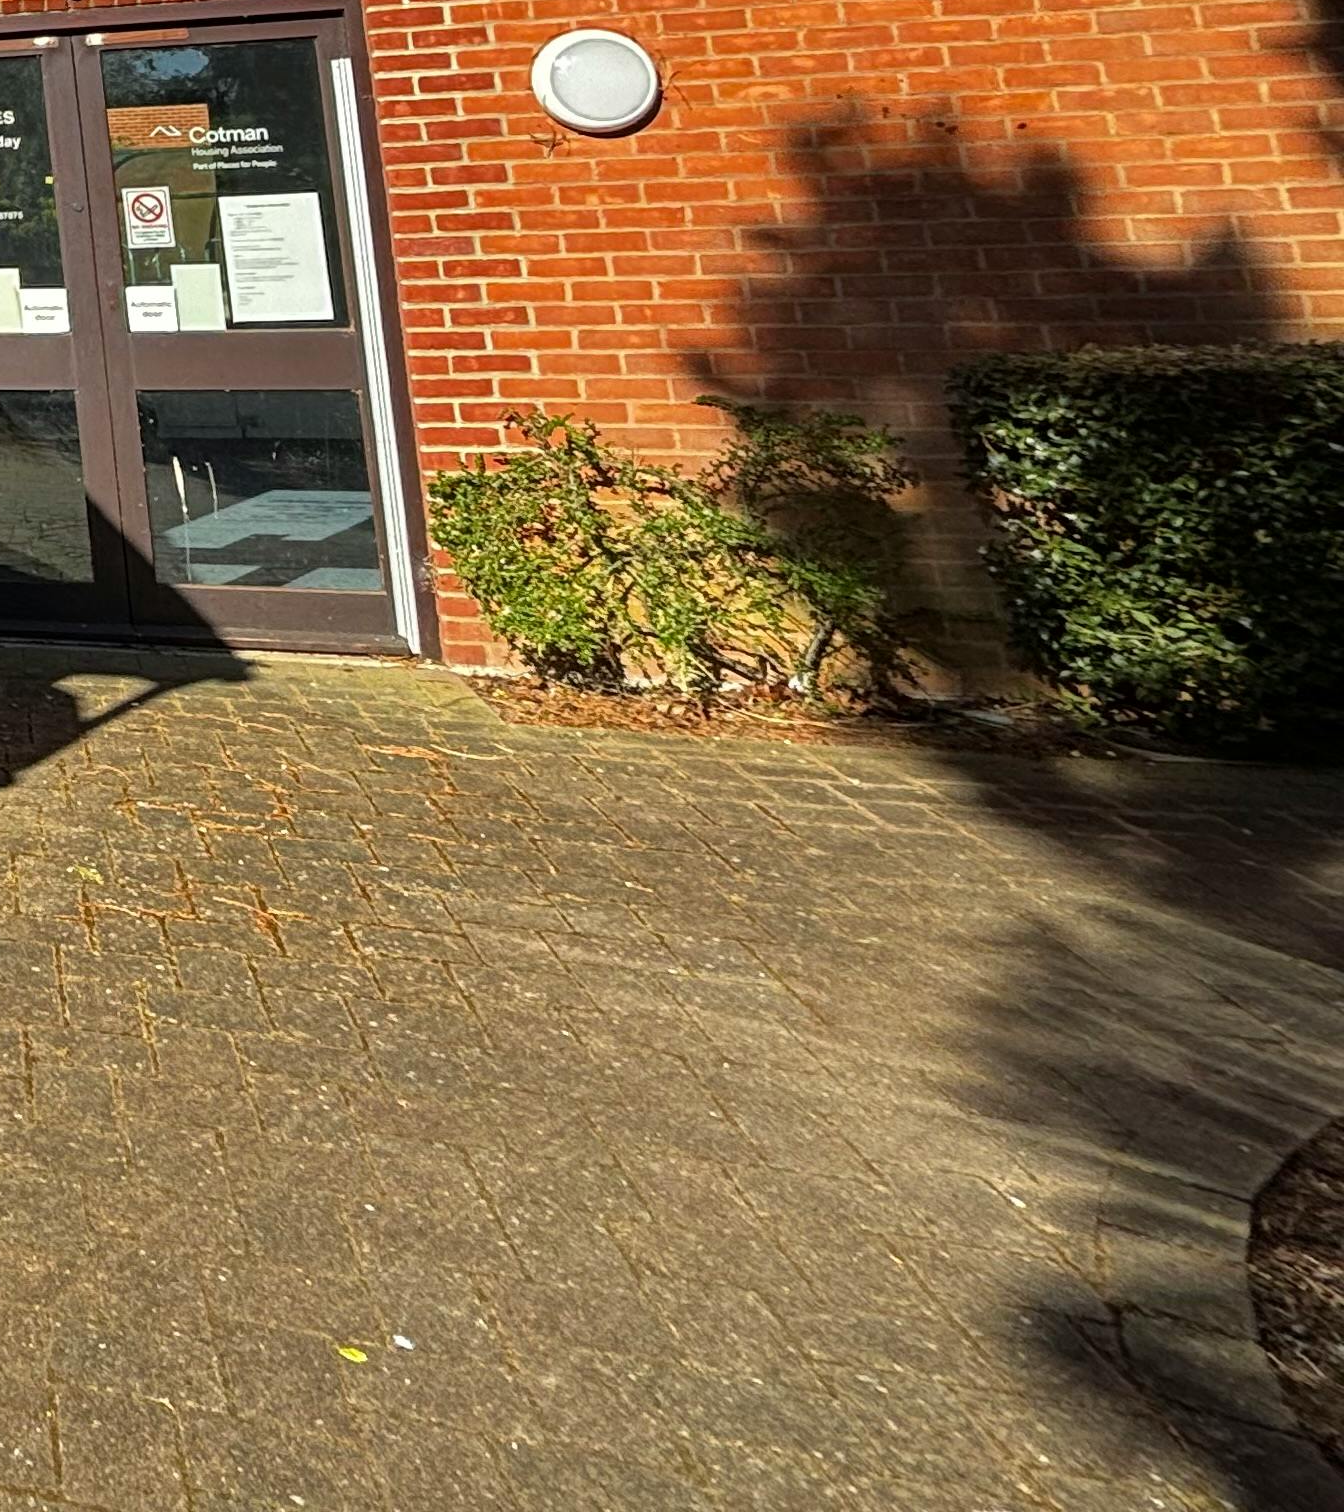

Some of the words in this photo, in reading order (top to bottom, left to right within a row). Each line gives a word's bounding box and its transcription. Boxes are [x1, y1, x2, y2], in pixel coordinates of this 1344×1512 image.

[189, 126, 269, 144] Cotman
[191, 146, 229, 157] Housing
[230, 144, 284, 155] Association
